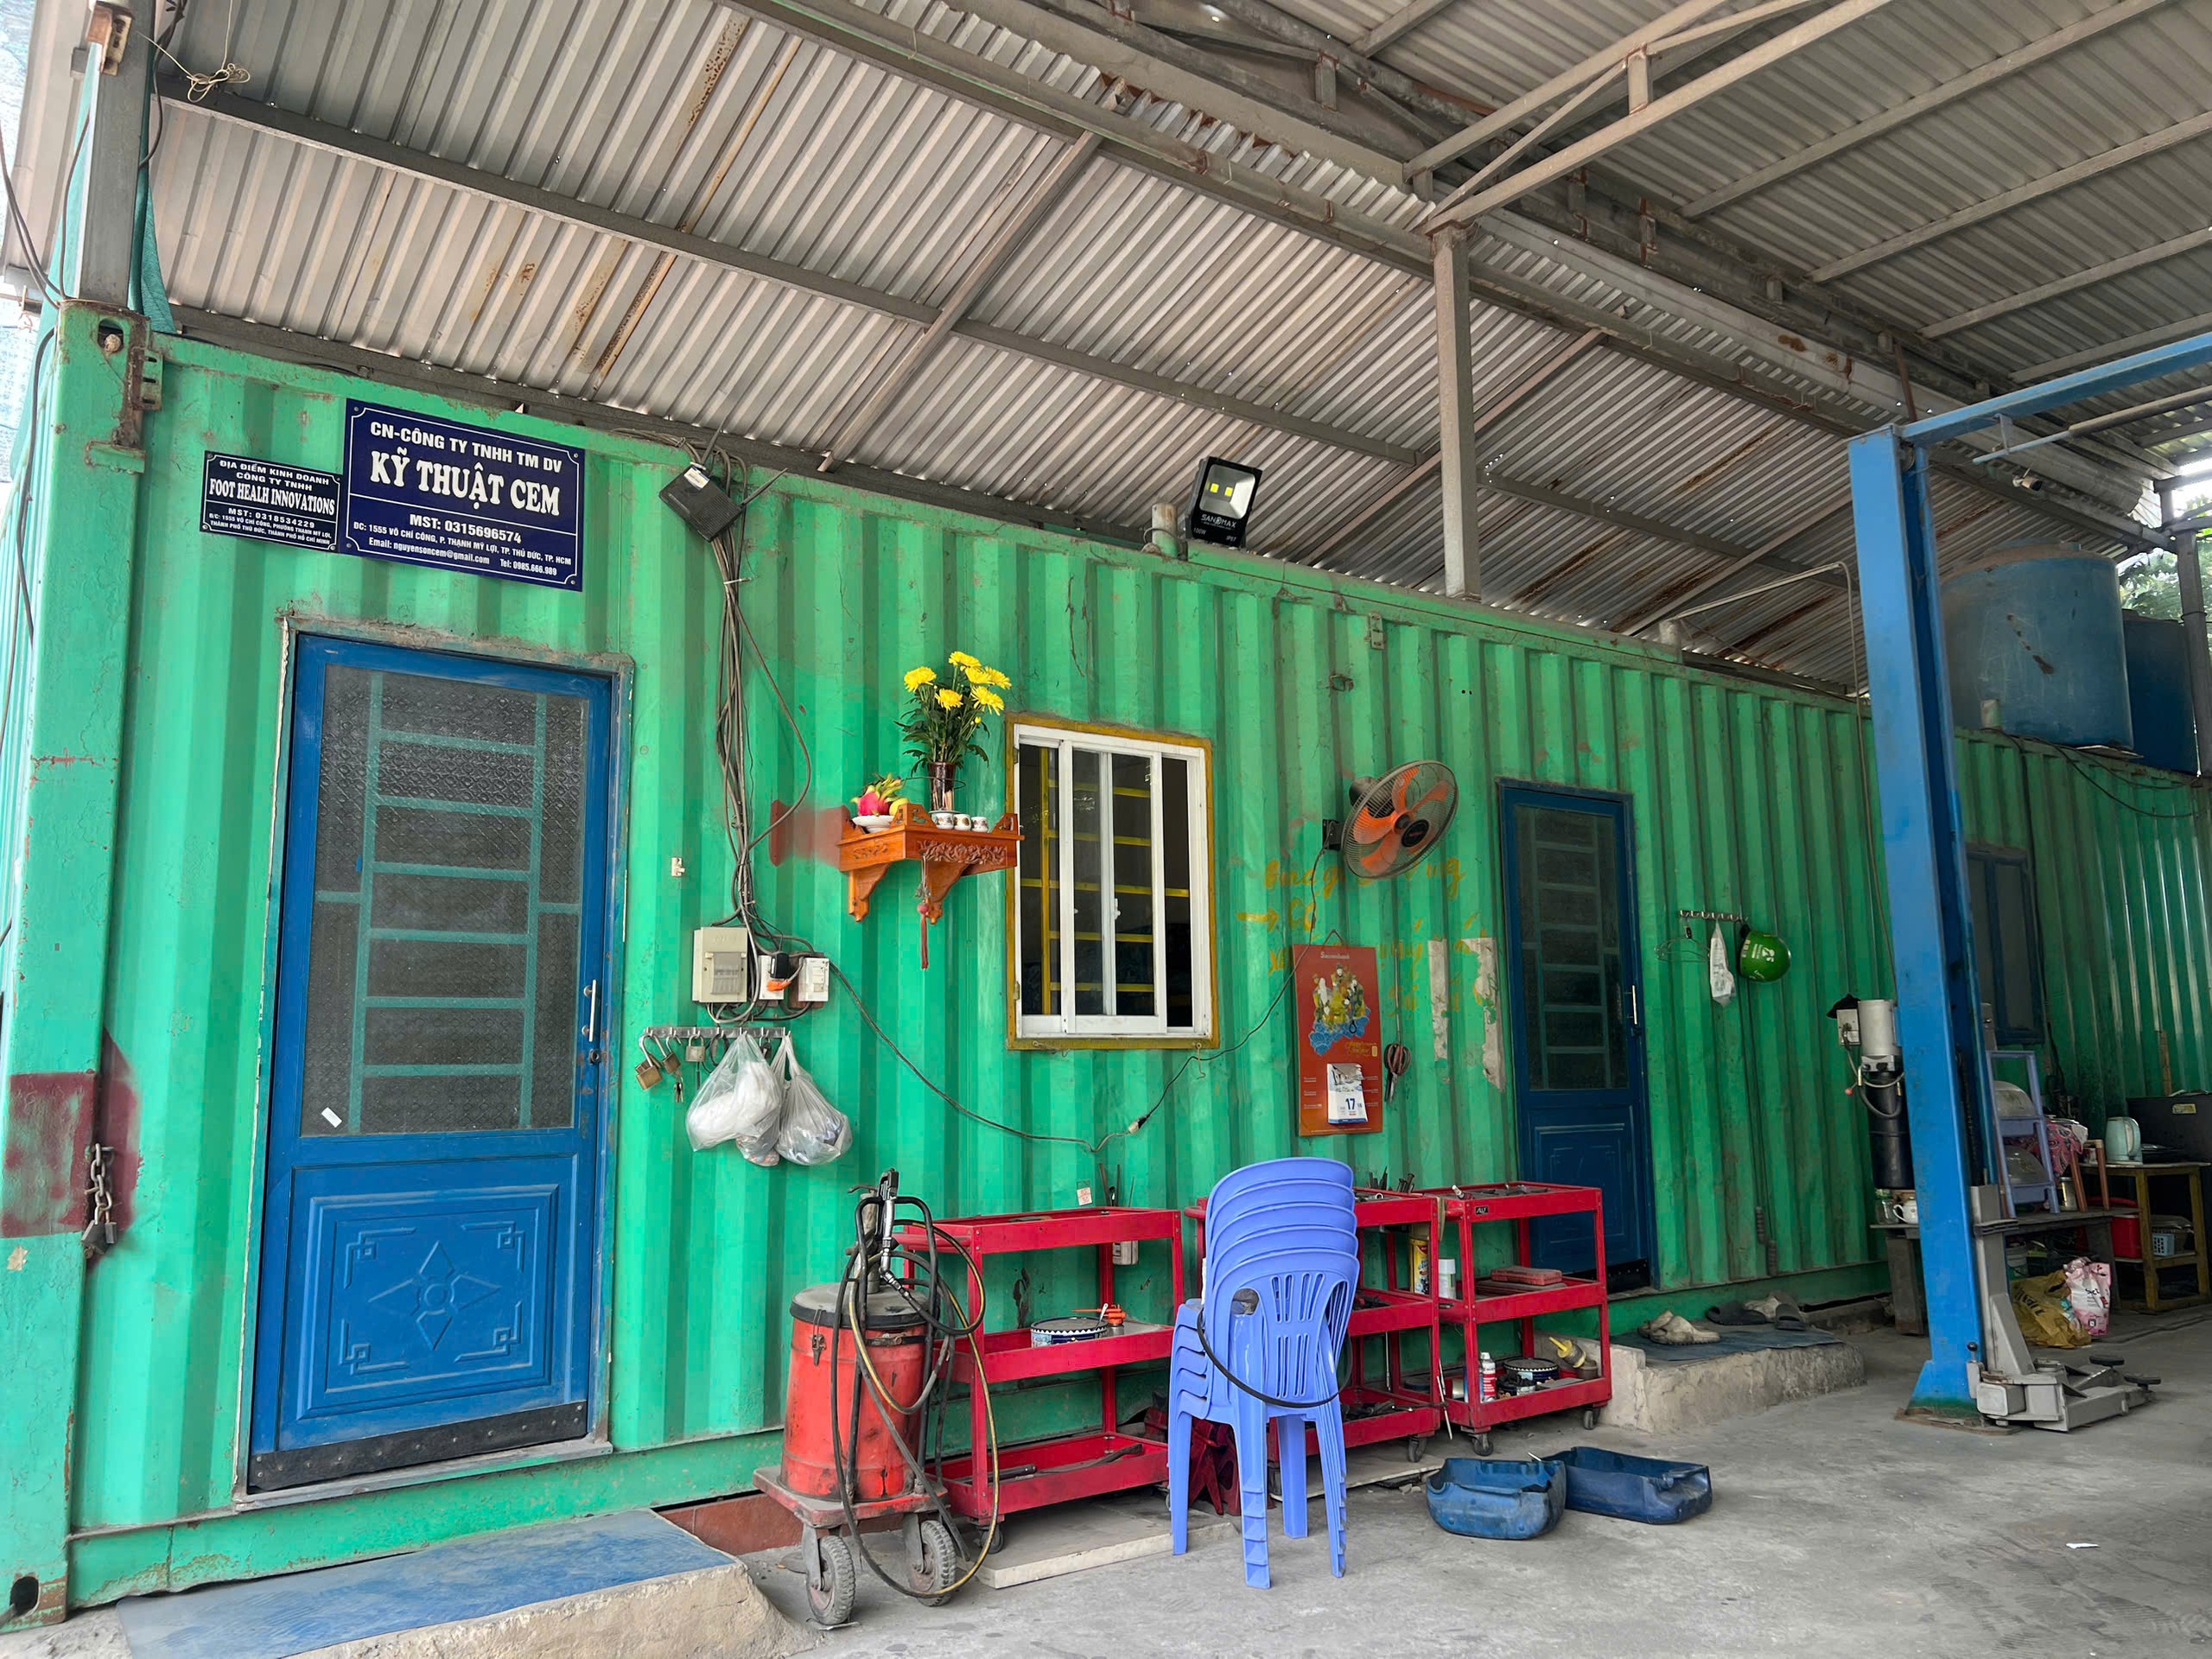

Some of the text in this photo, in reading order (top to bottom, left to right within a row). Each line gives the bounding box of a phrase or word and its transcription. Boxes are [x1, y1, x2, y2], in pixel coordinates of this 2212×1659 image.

[370, 422, 563, 474] CN-CÔNG TY TNHH TM DV
[219, 460, 329, 486] ĐỊA ĐIỂM KINH DOANH
[236, 472, 313, 491] CÔNG TY TNHH
[370, 446, 560, 516] KỸ THUẬT CEM
[209, 478, 335, 516] FOOT HEALH INNOVATIONS
[228, 508, 315, 529] MST: 0318534229
[410, 513, 522, 544] MST: 0315696574
[368, 537, 557, 576] Email: nguyensoncem@gmail.com Tel: 0985.666.989
[369, 524, 387, 534] 1555
[401, 529, 414, 539] CHÍ
[439, 536, 446, 544] P.
[501, 546, 511, 555] TP.
[544, 554, 555, 563] TP.
[556, 556, 572, 565] HCM
[1345, 1098, 1356, 1110] 17
